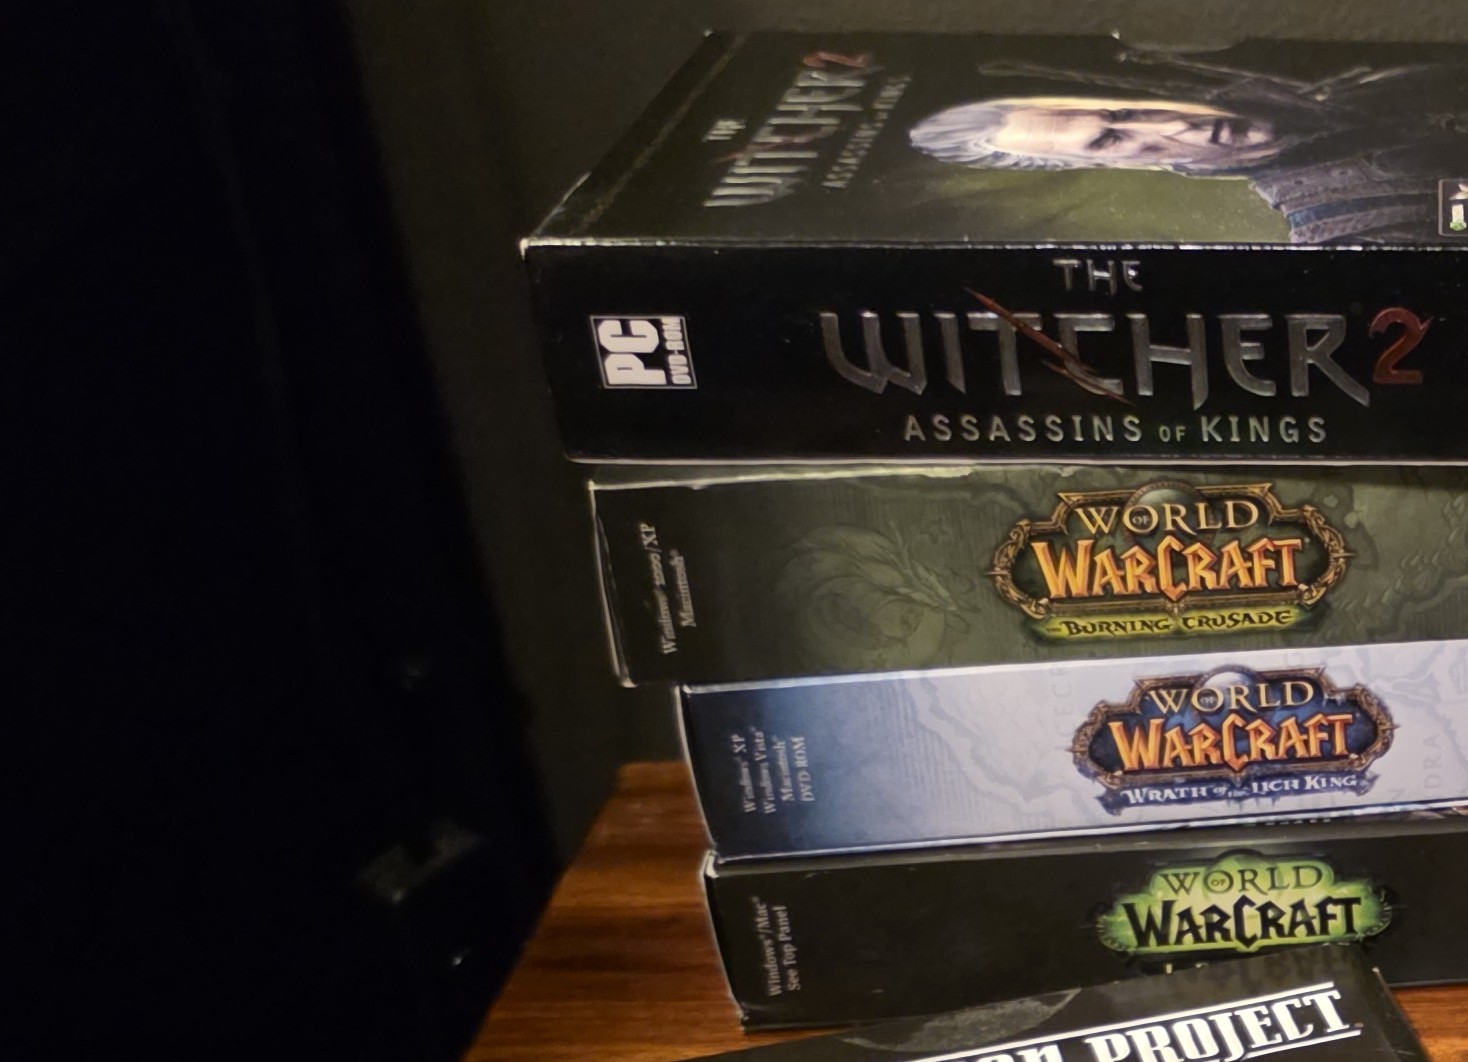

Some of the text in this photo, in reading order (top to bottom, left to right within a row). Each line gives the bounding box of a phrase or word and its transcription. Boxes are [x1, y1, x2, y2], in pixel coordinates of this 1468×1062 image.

[1052, 258, 1143, 294] THE
[597, 319, 667, 386] PC
[819, 306, 1433, 412] WITCHER 2
[903, 414, 1328, 443] ASSASSINS OF KINGS
[1074, 499, 1261, 536] WORLD
[1030, 534, 1302, 601] WARCRAFT
[1060, 609, 1293, 637] BURNING CRUSADE
[1148, 680, 1316, 713] WORLD
[1107, 713, 1354, 773] WARCRAFT
[1120, 787, 1207, 805] WRATH
[1302, 775, 1357, 791] KING
[1159, 864, 1324, 897] WORLD
[1210, 878, 1227, 888] OF
[1121, 894, 1362, 950] WARCRAFT
[772, 905, 801, 991] See Top Panel
